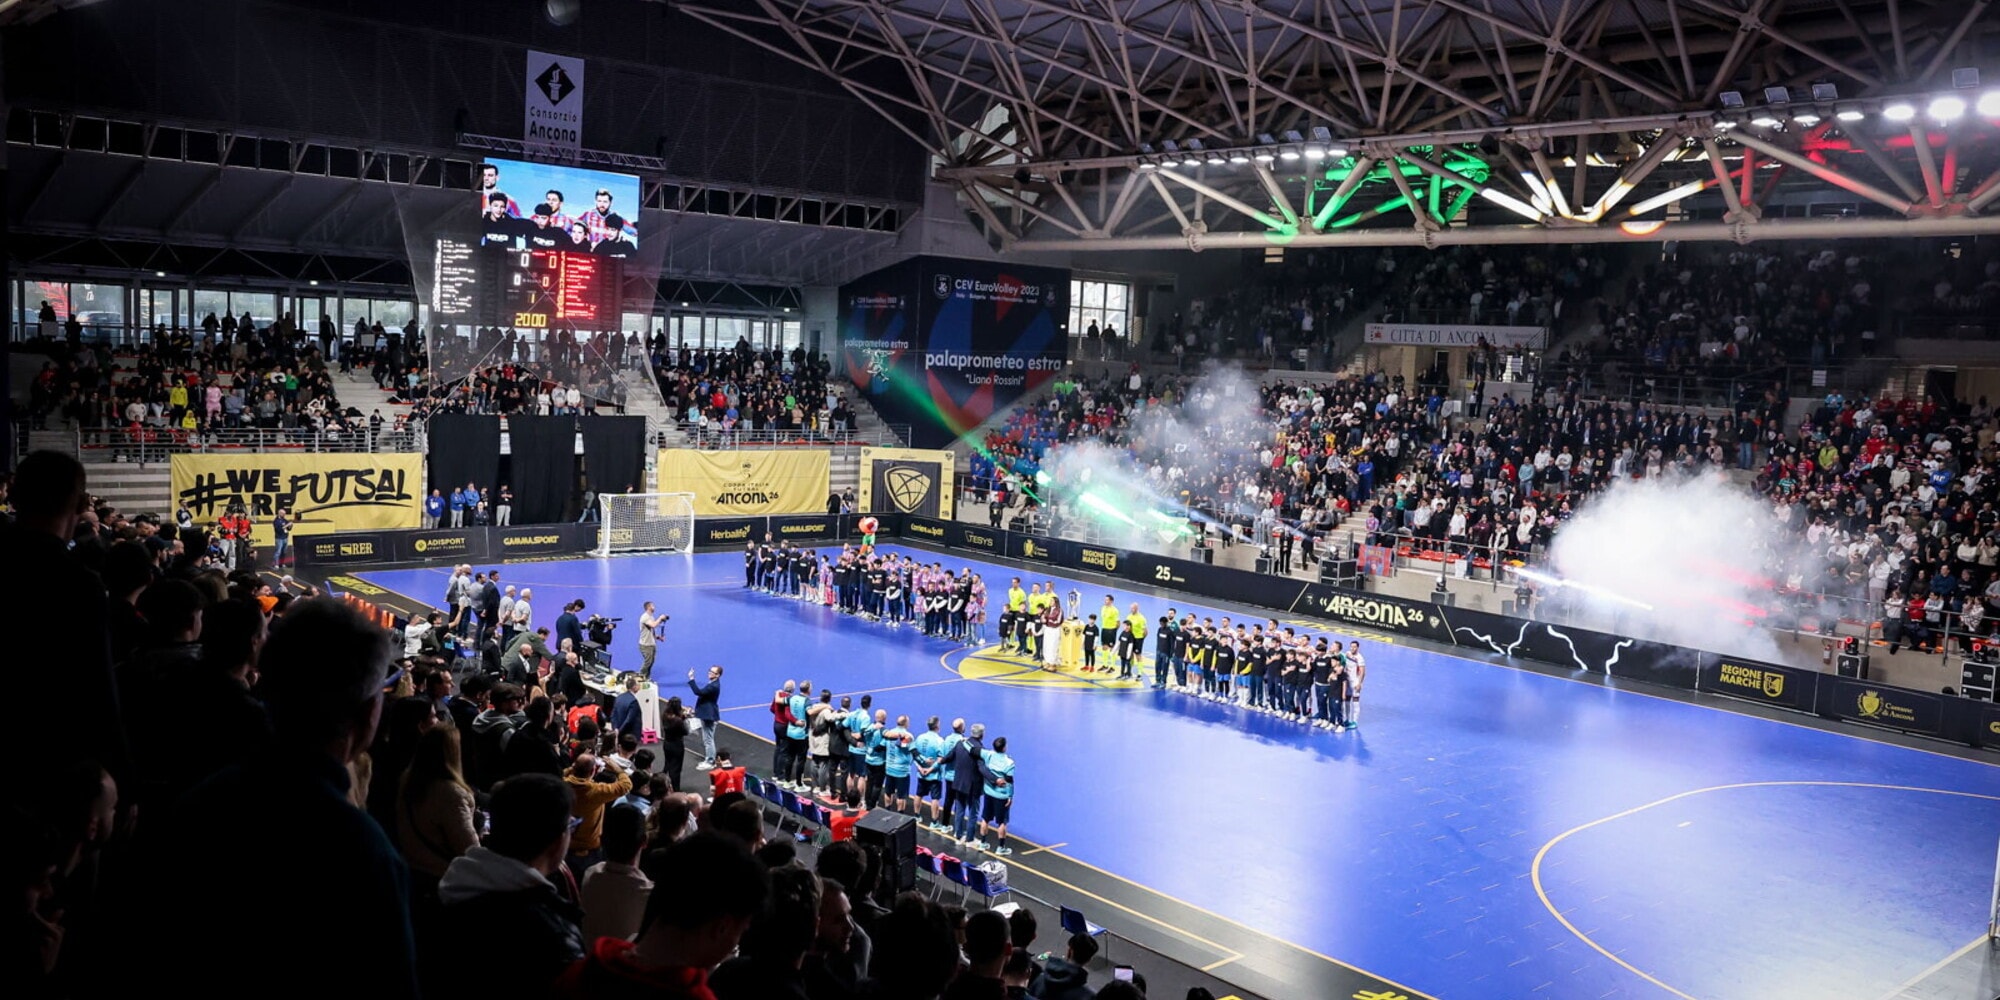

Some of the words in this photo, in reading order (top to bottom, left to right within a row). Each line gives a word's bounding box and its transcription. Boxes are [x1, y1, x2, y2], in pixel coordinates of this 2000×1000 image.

[530, 106, 577, 122] Consorzio
[529, 120, 577, 142] Ancona
[521, 253, 529, 267] 0
[549, 255, 557, 269] 0
[954, 279, 973, 290] CEV
[974, 281, 1018, 296] EuroVolley
[1020, 286, 1040, 296] 2023
[844, 338, 889, 349] palaprometeo
[890, 340, 909, 349] estra
[1429, 329, 1441, 343] DI
[925, 349, 1025, 371] palaprometeo
[1028, 356, 1062, 371] estra
[289, 469, 413, 505] FUTSAL
[711, 527, 747, 539] Herbalife
[351, 542, 374, 555] RER
[427, 537, 465, 546] ADISPORT
[1155, 565, 1171, 580] 25
[1325, 595, 1408, 628] ANCONA
[1407, 608, 1425, 622] 26
[1721, 664, 1762, 680] REGIONE
[1720, 673, 1761, 689] MARCHE
